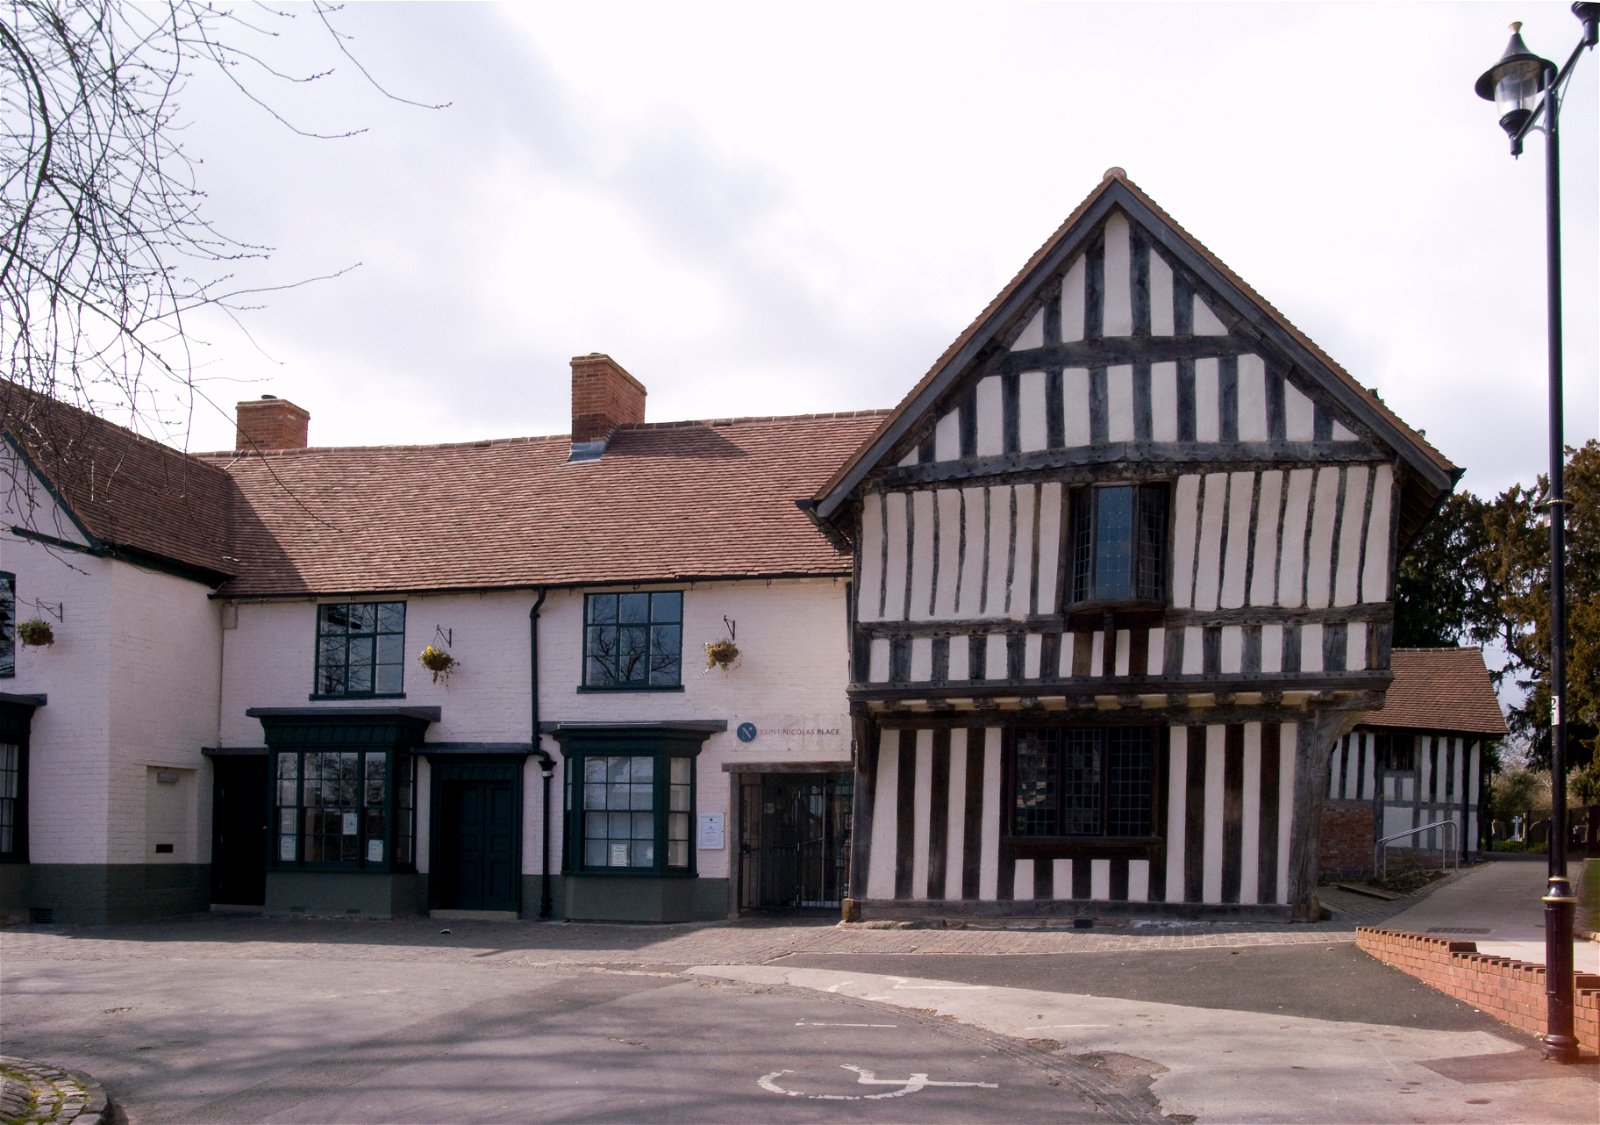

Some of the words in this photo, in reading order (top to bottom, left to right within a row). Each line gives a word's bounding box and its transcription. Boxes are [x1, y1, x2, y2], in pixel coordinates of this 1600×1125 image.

[759, 728, 781, 736] SAINT
[782, 728, 815, 736] NICOLAS
[816, 728, 840, 736] PLACE
